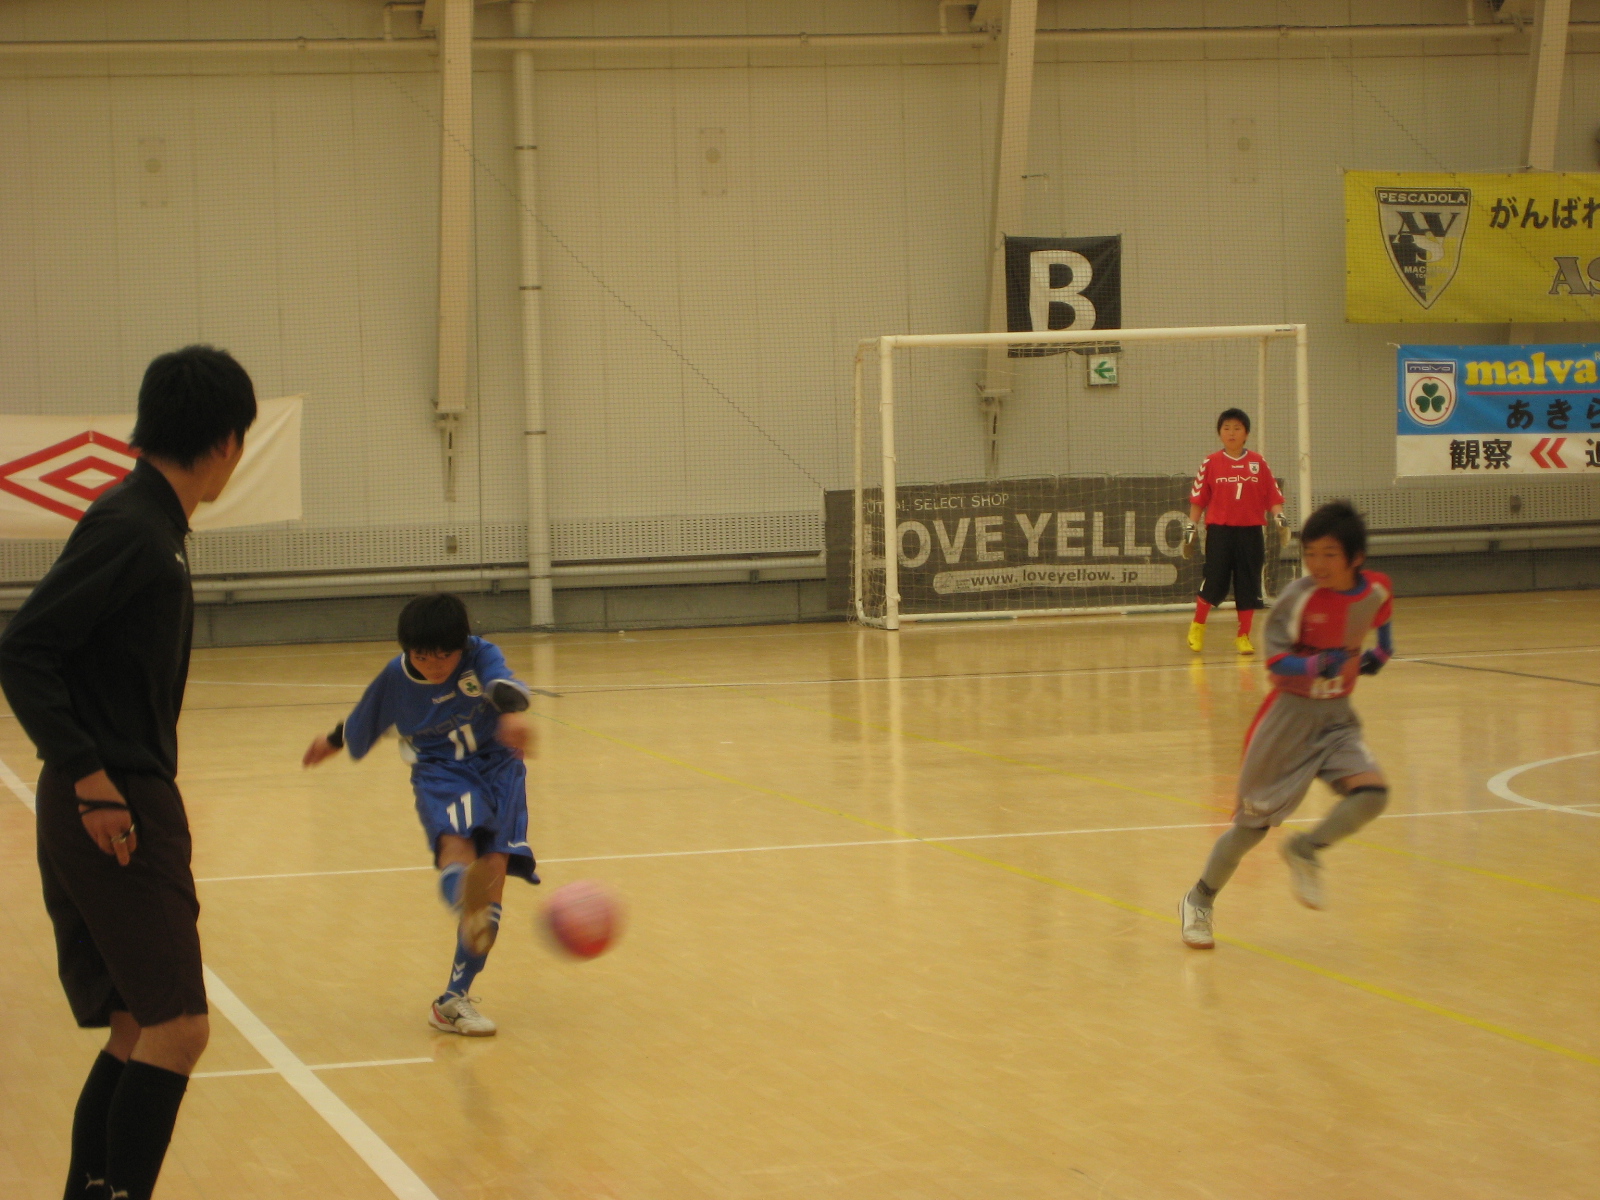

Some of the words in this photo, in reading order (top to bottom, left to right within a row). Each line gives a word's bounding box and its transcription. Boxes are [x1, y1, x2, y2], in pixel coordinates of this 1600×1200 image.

[1379, 192, 1467, 204] PESCADOLA
[1029, 249, 1097, 332] B
[1465, 351, 1598, 386] malva
[1449, 438, 1513, 470] 観察
[1215, 474, 1259, 484] malva
[1235, 482, 1243, 500] 1
[914, 496, 965, 511] SELECT
[971, 493, 1009, 508] SHOP
[1015, 510, 1206, 558] YELLO
[448, 723, 477, 761] 11
[446, 791, 472, 833] 11
